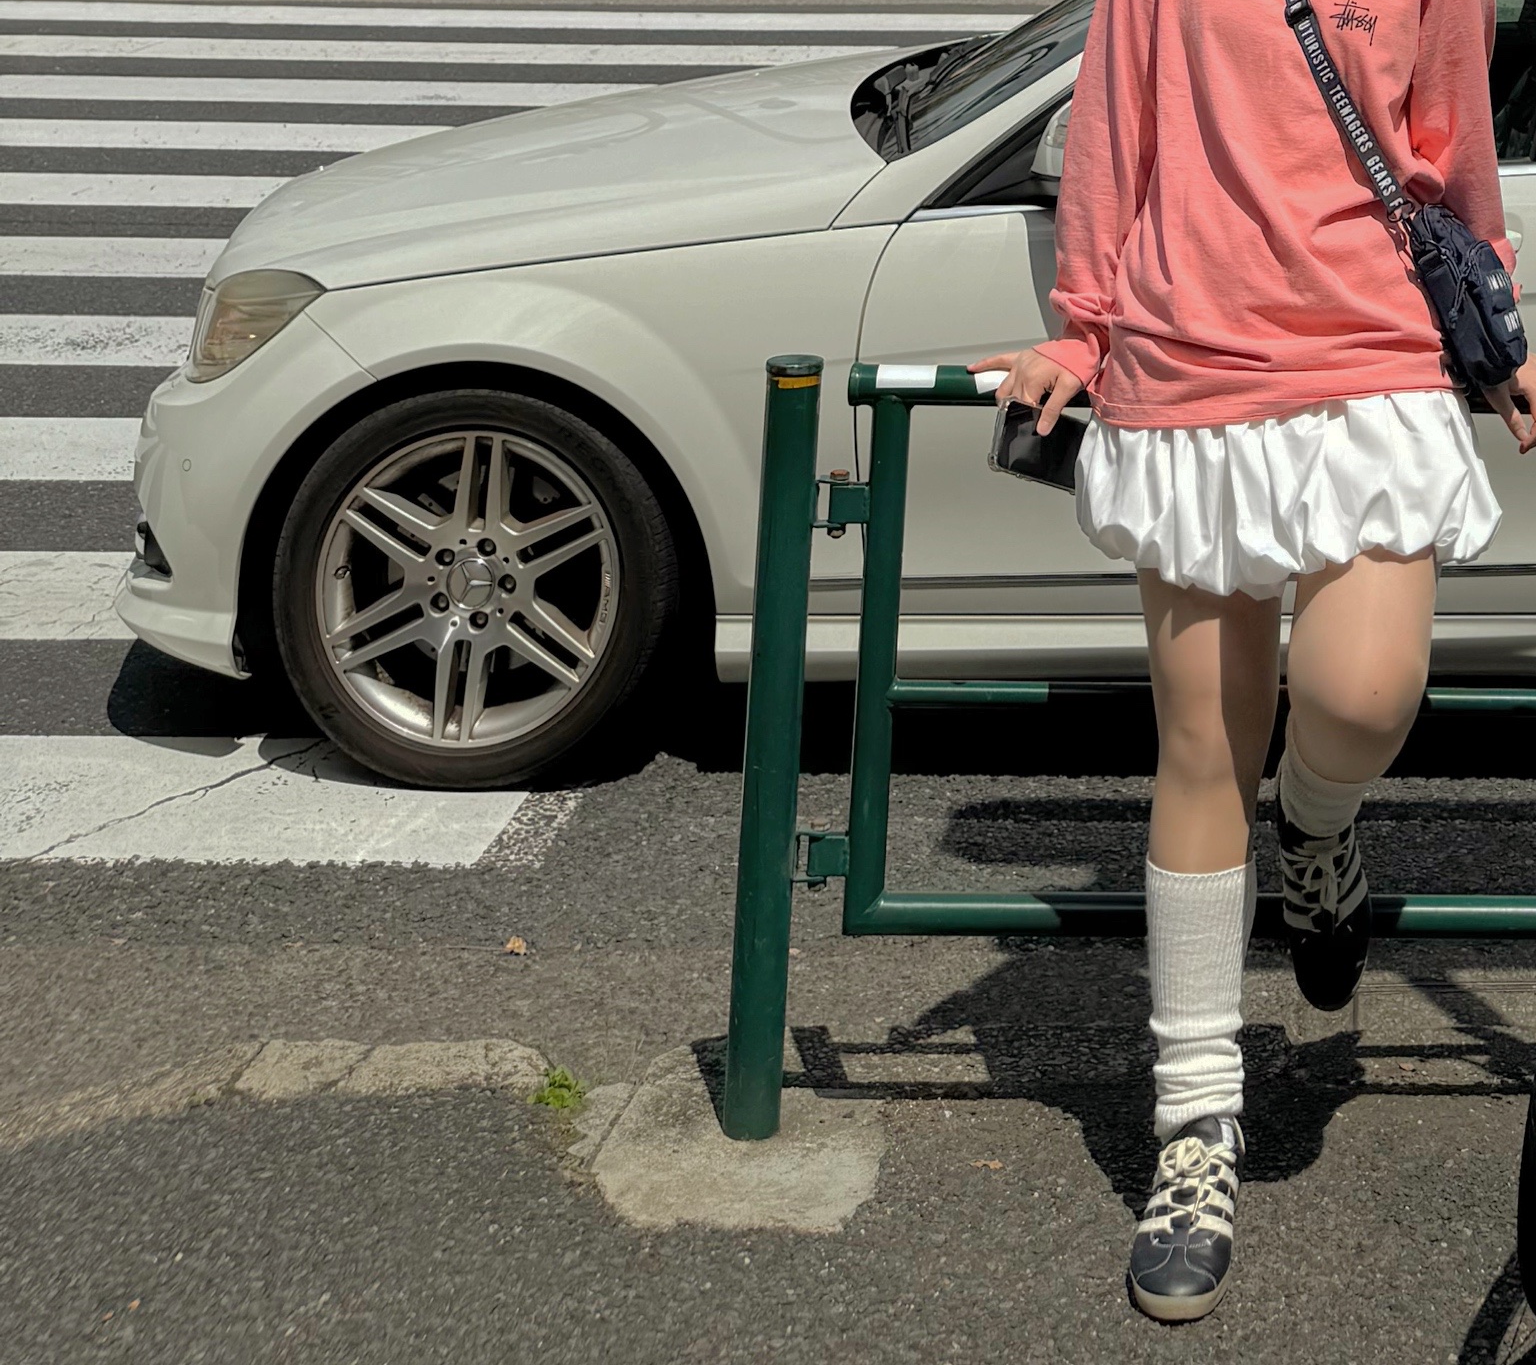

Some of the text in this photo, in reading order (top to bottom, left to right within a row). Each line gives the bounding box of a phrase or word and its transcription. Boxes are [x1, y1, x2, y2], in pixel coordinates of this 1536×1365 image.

[1298, 18, 1335, 83] UTURISTIC
[1328, 84, 1374, 153] TEENAGERS
[1365, 155, 1396, 197] GEARS
